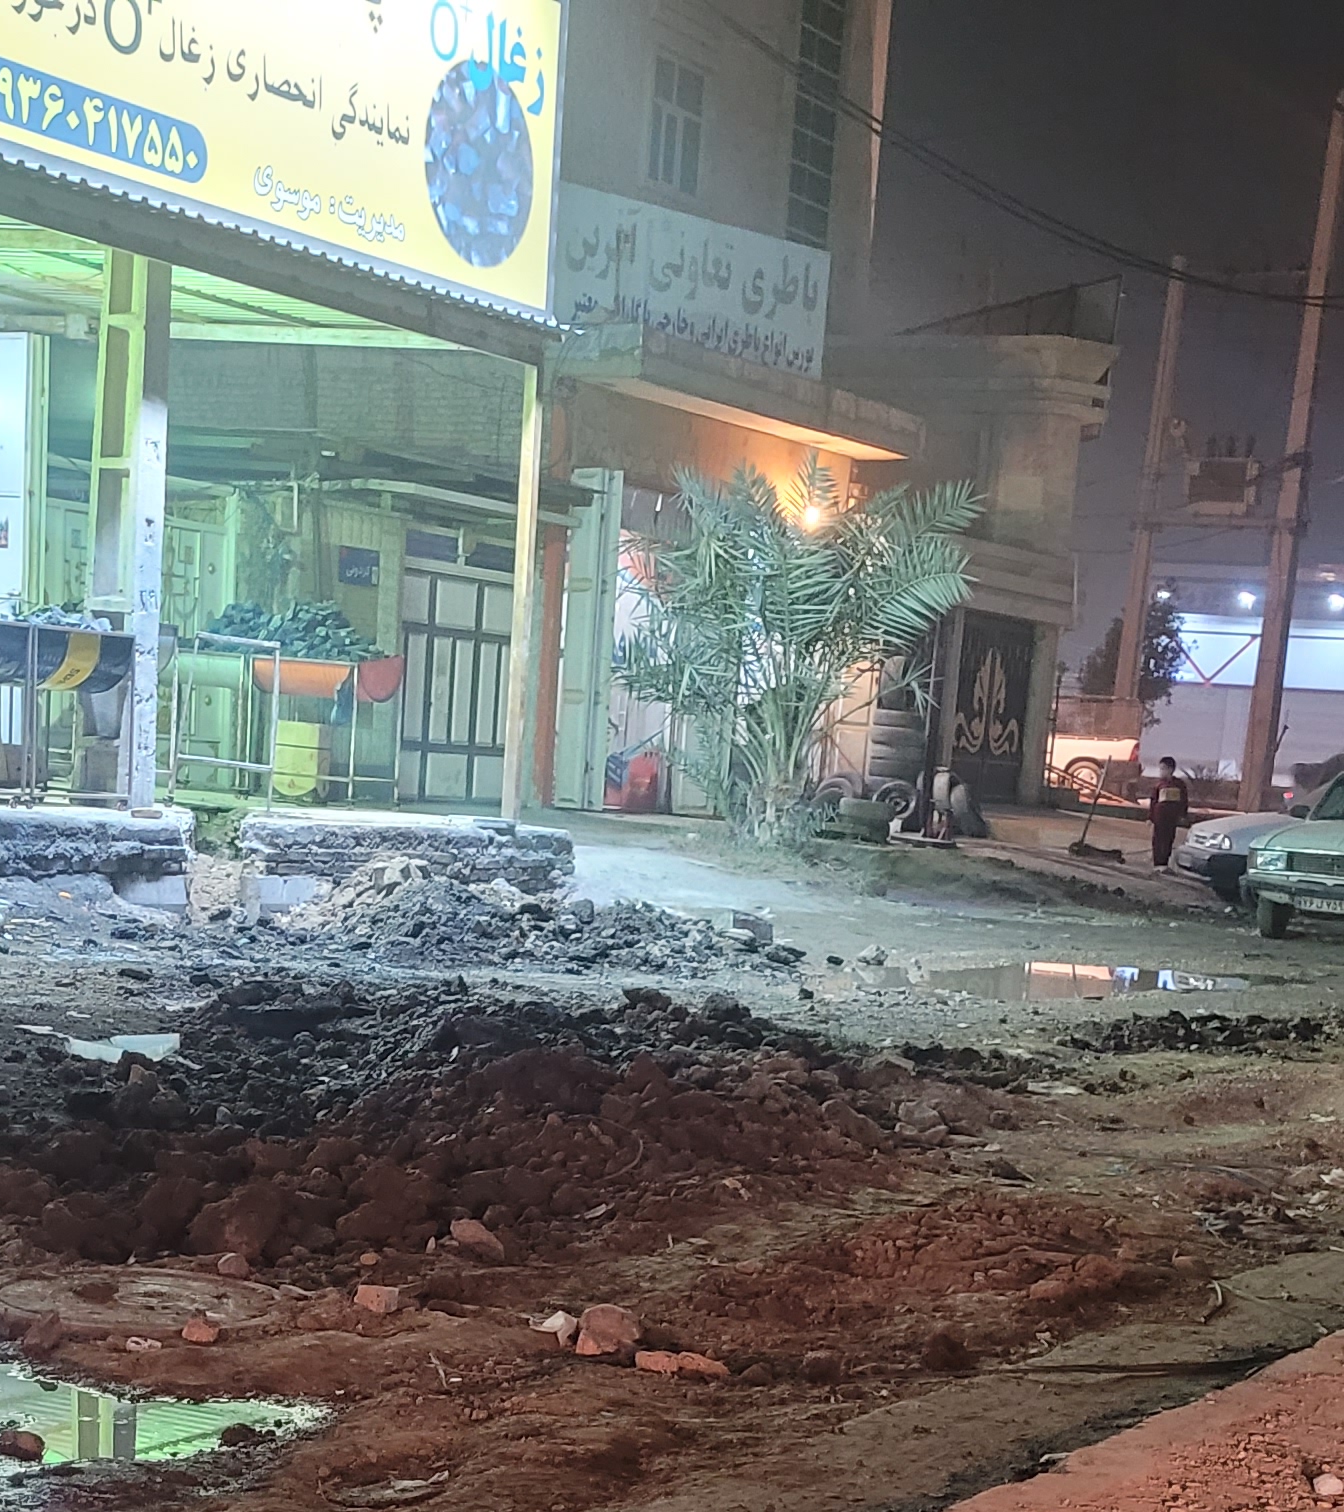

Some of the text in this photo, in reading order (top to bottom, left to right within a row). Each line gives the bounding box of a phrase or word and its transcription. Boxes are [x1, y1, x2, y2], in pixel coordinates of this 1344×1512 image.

[159, 16, 216, 85] زغال
[226, 48, 323, 111] انحصاری
[468, 10, 545, 116] زغال
[330, 82, 410, 147] نمایندگی
[253, 164, 322, 220] موسوی
[649, 230, 733, 301] تعاونی
[742, 254, 819, 326] باطری
